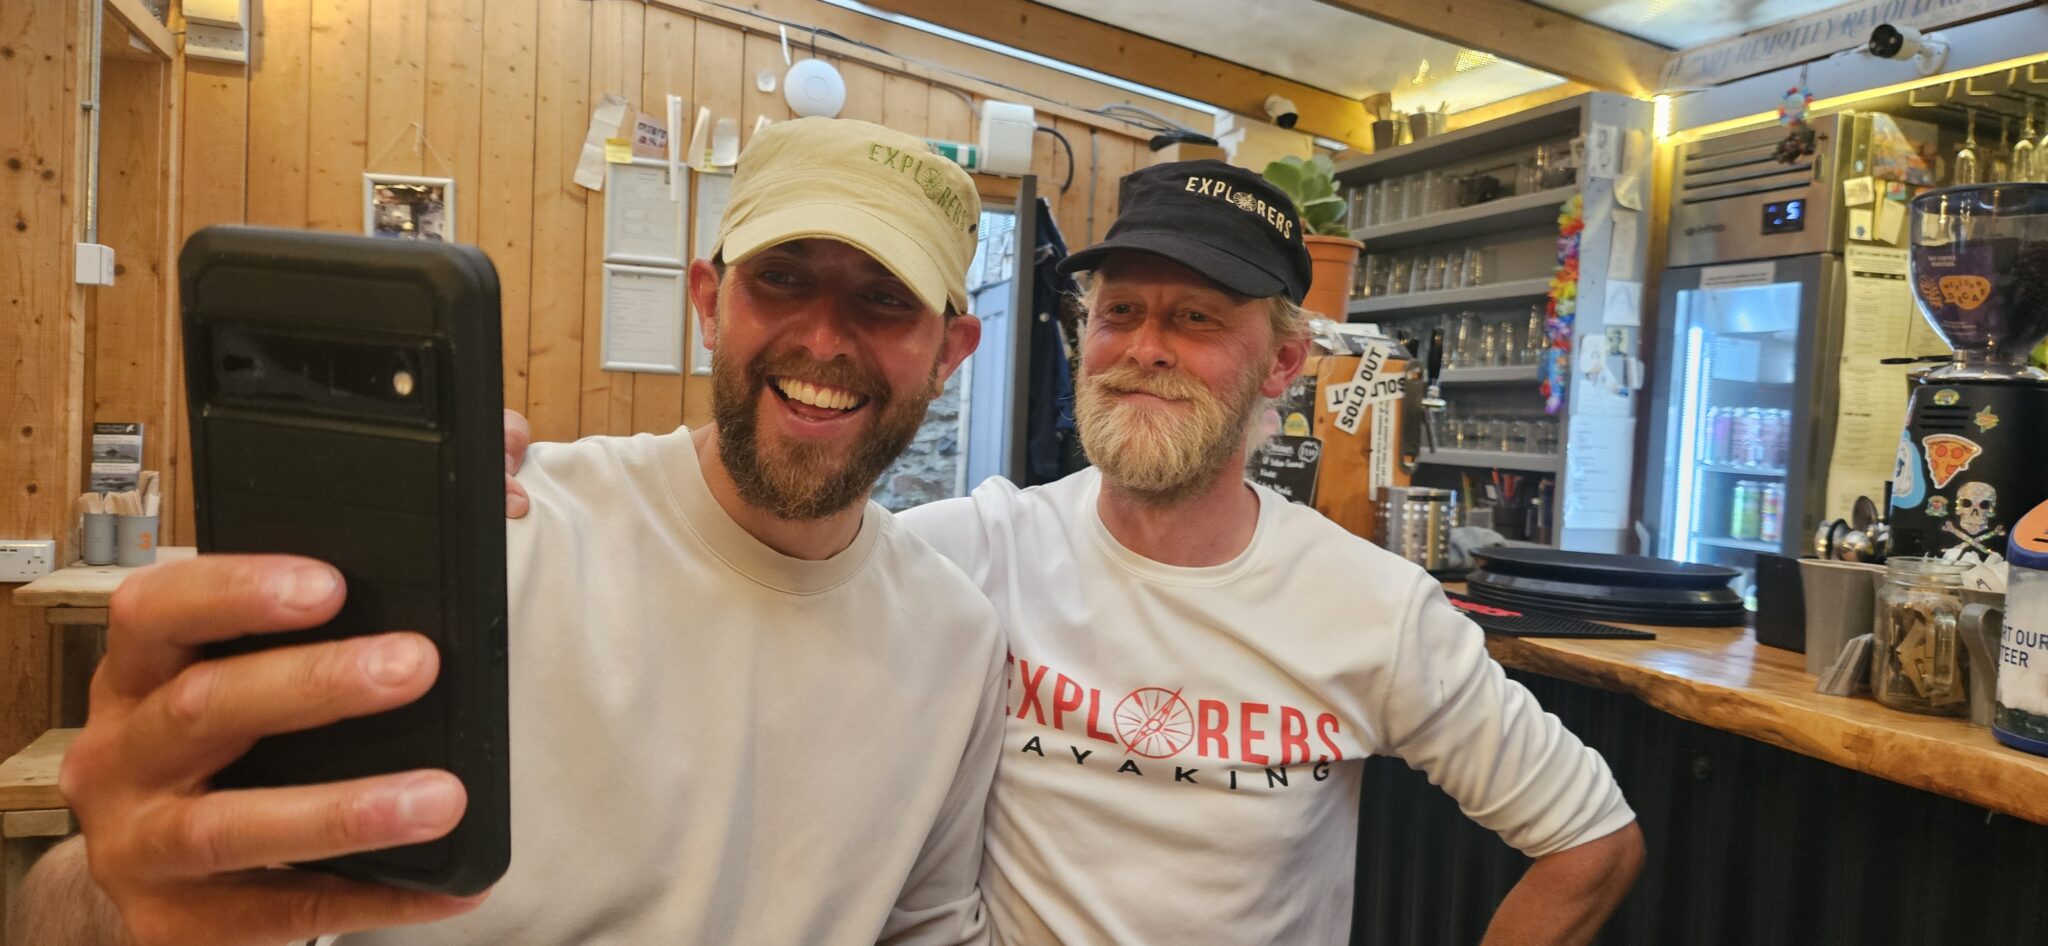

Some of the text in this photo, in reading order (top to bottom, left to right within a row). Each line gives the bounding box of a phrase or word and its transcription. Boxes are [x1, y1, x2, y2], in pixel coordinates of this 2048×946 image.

[868, 142, 967, 232] EXPLORERS
[1185, 176, 1293, 239] EXPLORERS
[1341, 385, 1366, 428] SOLD
[1361, 346, 1382, 381] OUT
[1006, 650, 1343, 768] XPLORERS
[1021, 735, 1330, 790] AYAKING
